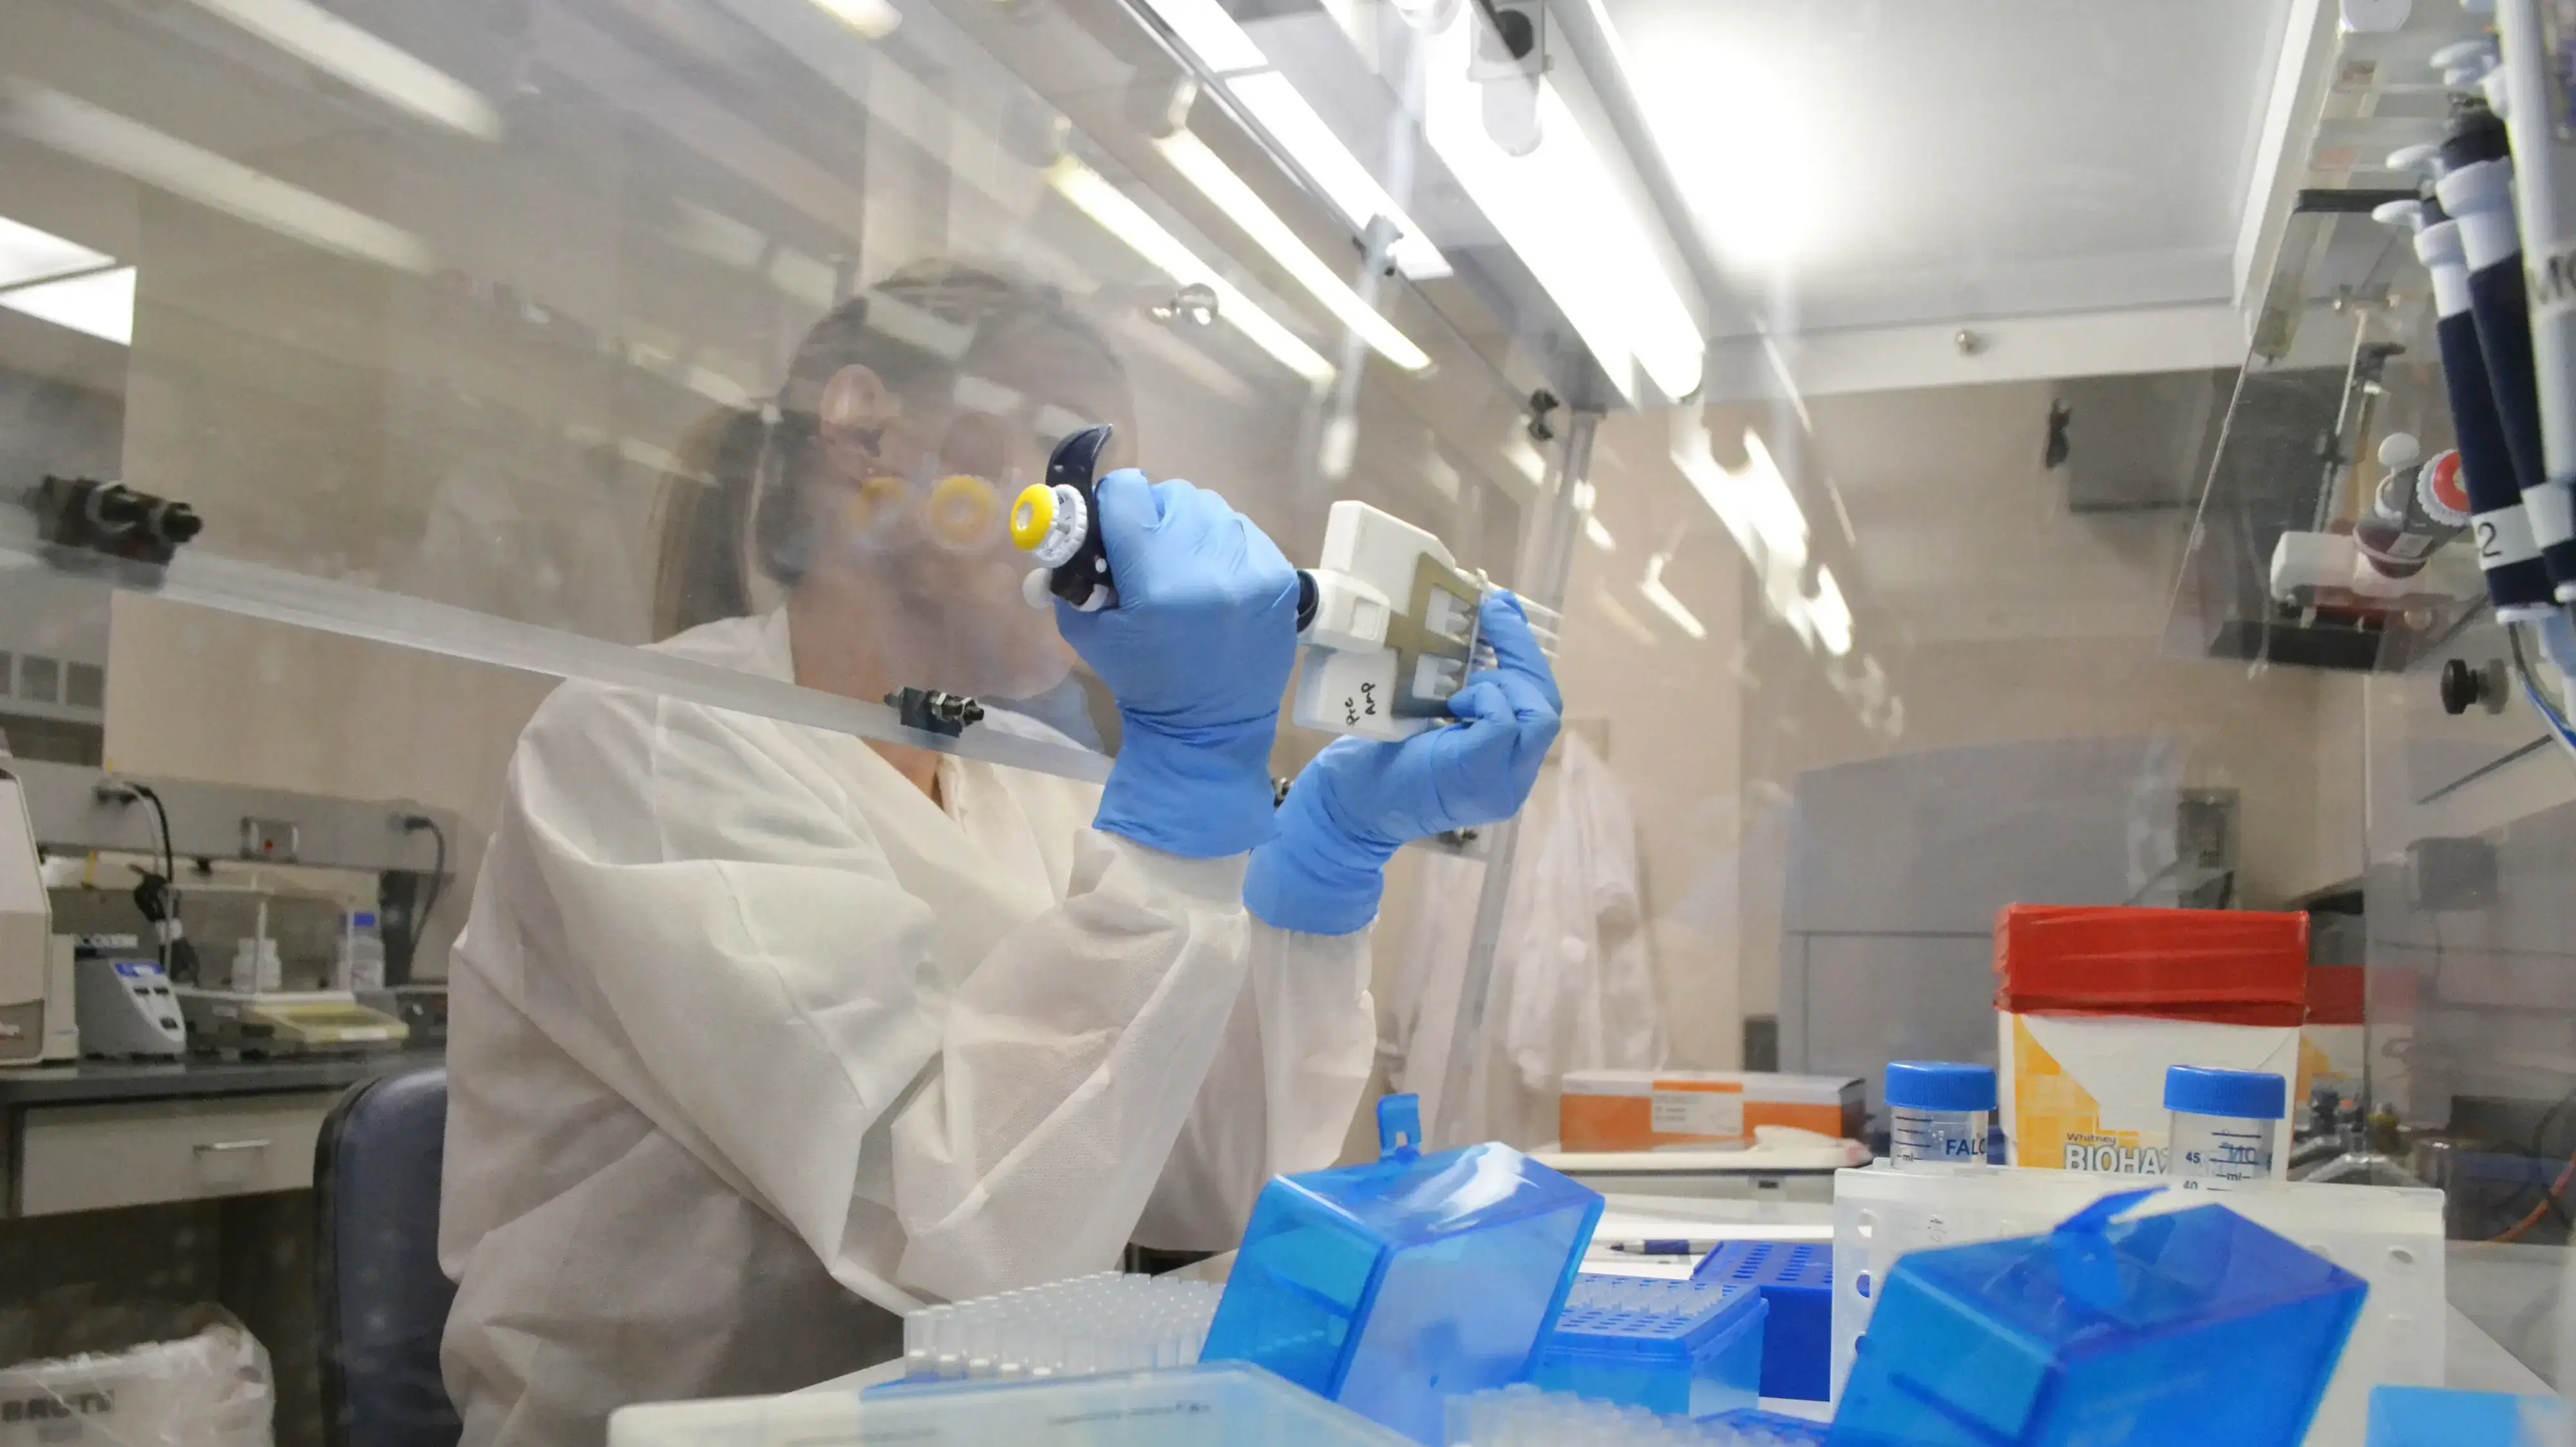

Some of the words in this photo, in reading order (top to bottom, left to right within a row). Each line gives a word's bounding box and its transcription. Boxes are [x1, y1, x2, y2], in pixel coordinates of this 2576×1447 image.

[2479, 522, 2503, 558] 2
[2067, 1133, 2116, 1146] Whitney
[2185, 1151, 2201, 1164] 45
[2226, 1171, 2242, 1181] ml
